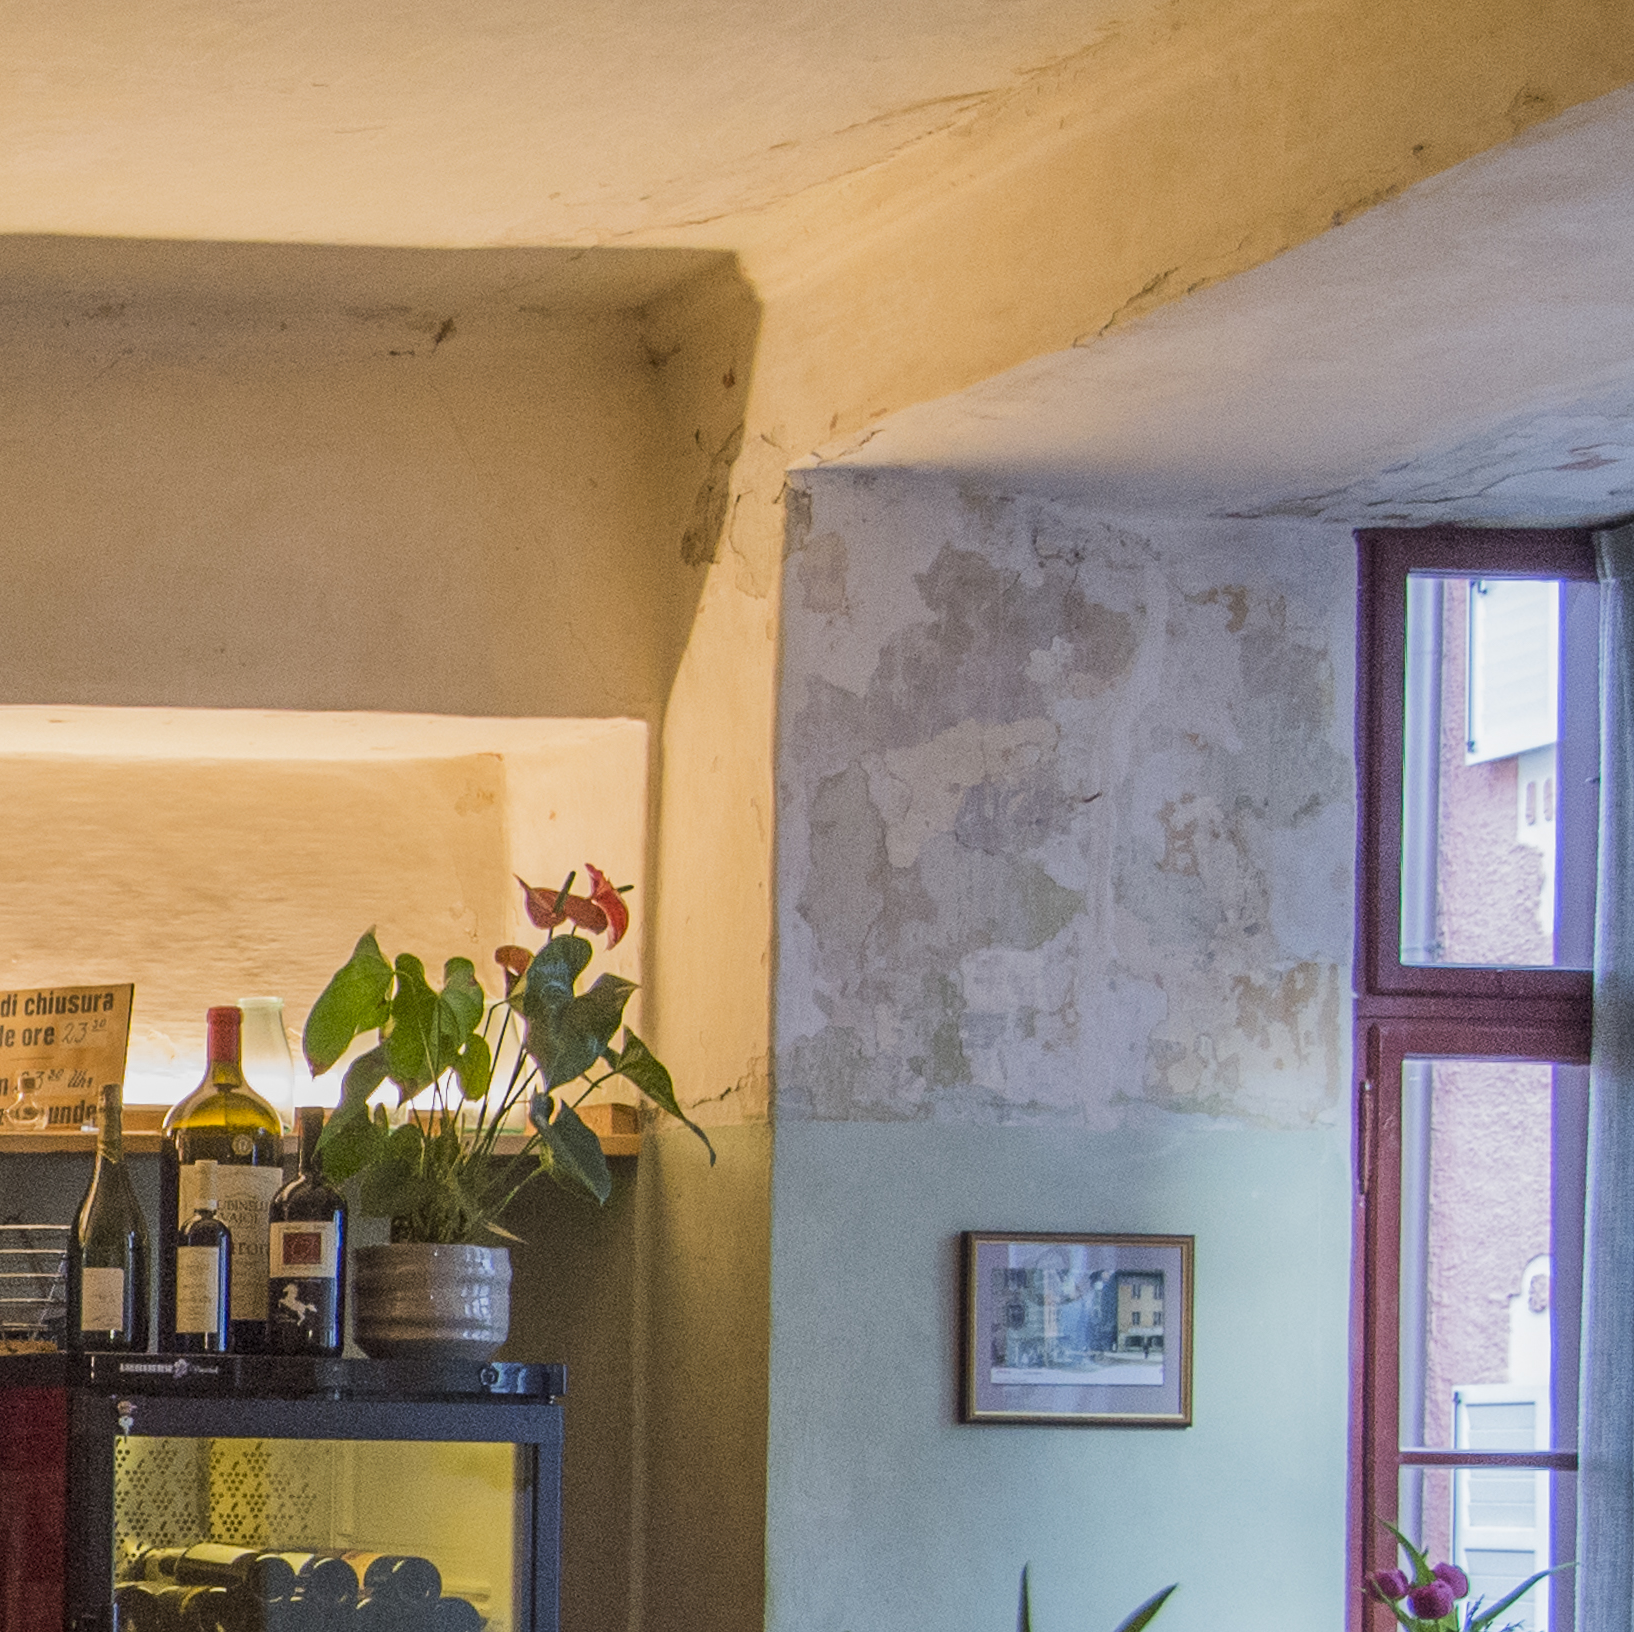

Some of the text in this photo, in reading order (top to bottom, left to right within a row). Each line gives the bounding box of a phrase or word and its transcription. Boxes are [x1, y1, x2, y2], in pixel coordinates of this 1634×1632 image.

[0, 994, 17, 1017] di
[24, 991, 114, 1016] chiusura
[22, 1026, 55, 1046] ore
